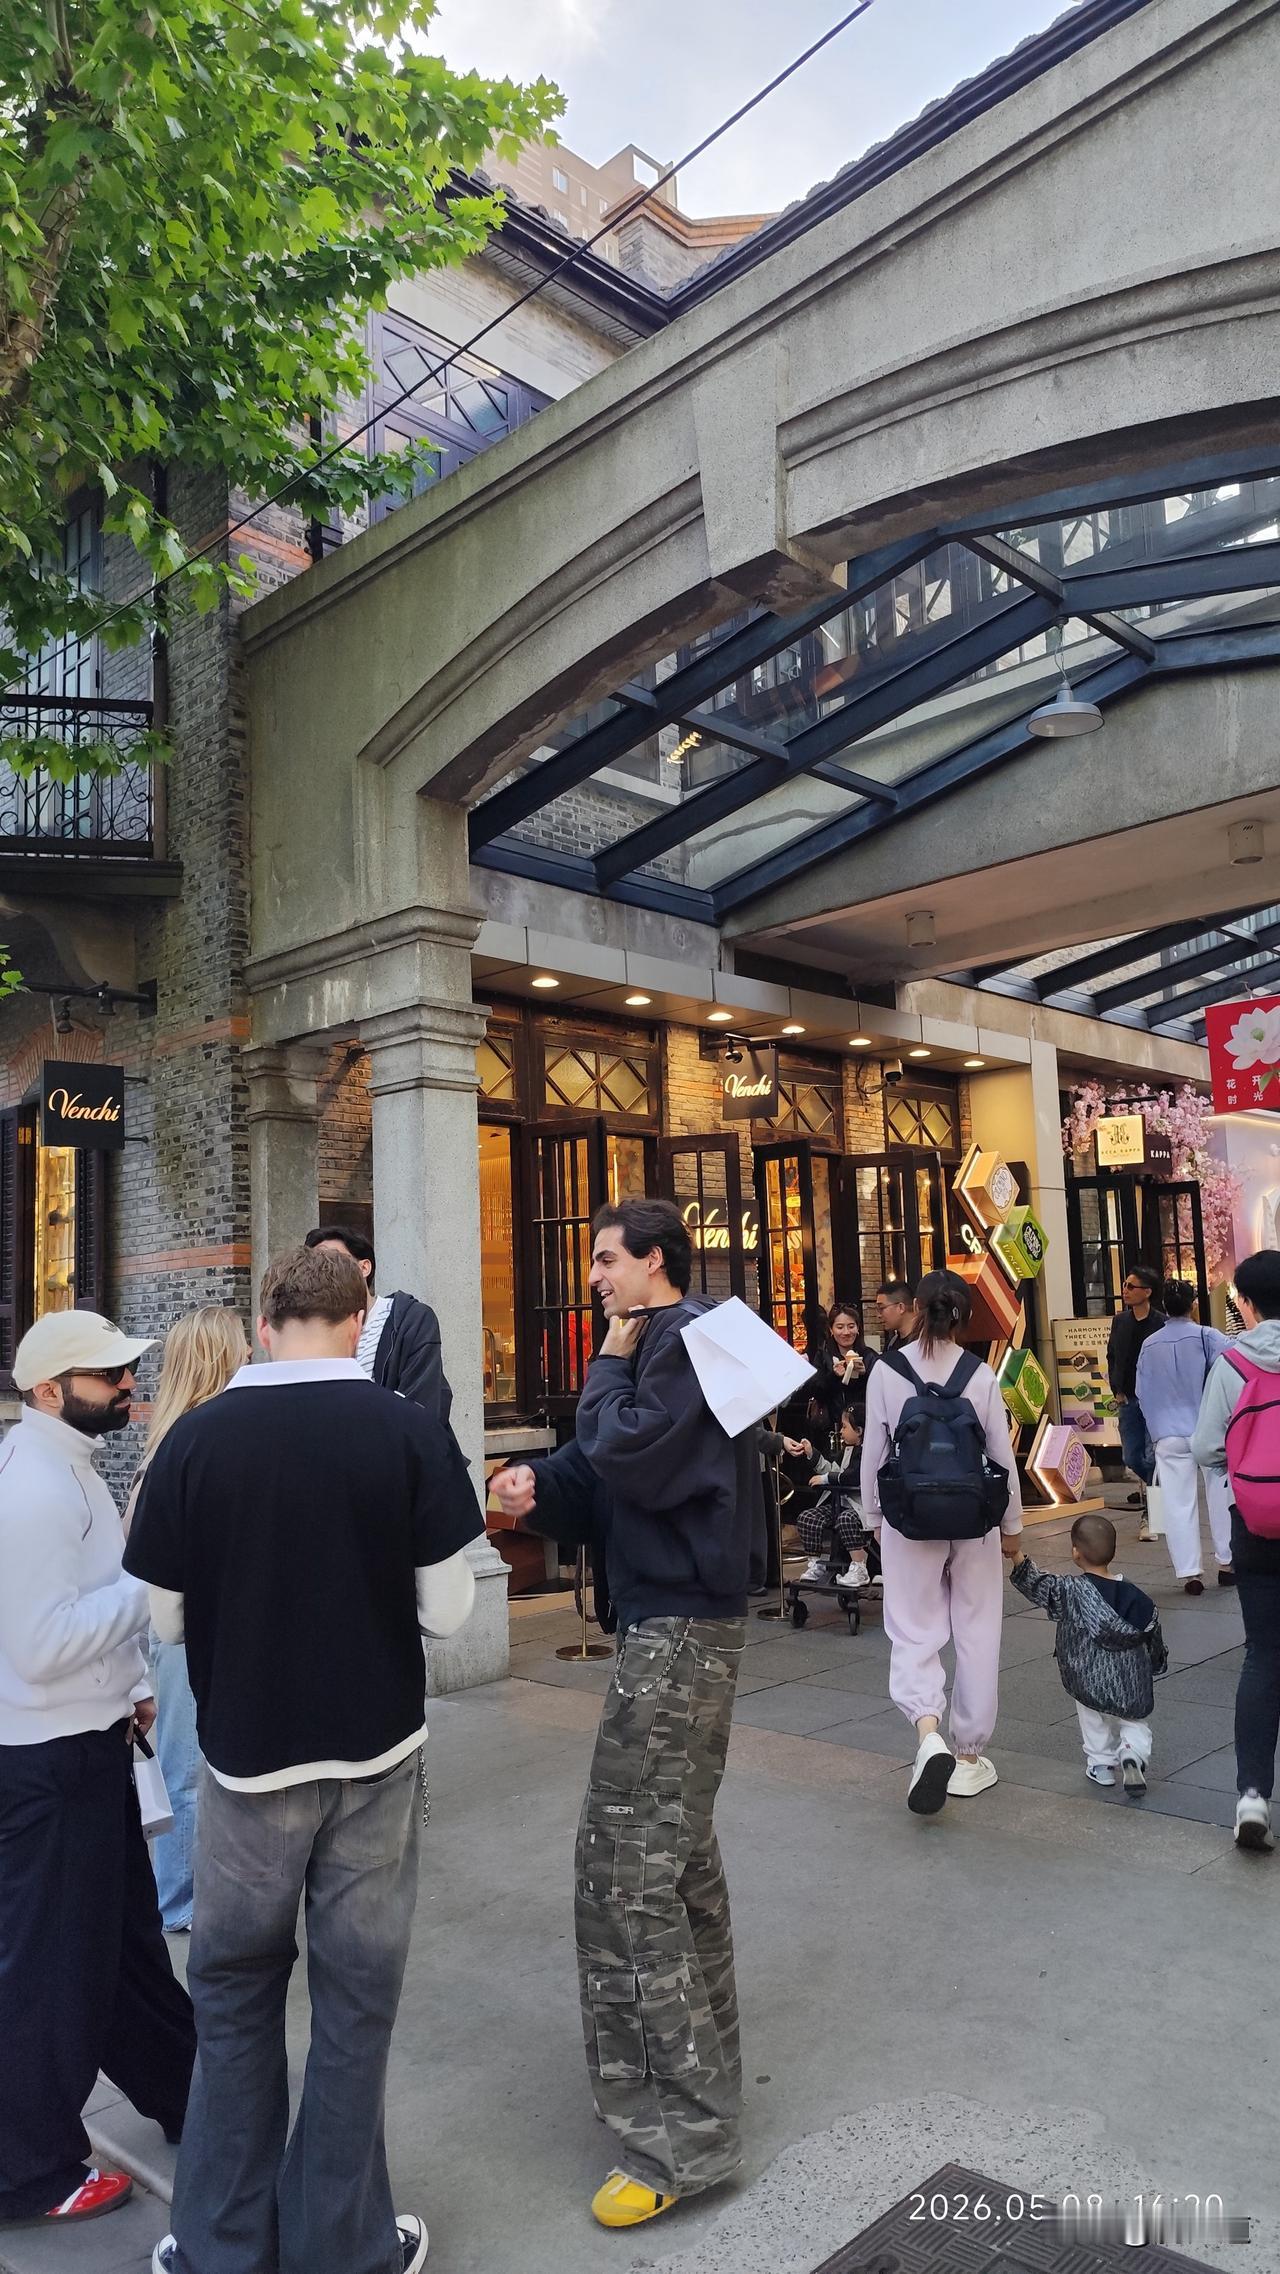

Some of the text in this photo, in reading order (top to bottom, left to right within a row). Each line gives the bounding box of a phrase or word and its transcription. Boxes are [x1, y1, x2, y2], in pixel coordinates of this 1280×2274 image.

[725, 1073, 772, 1098] Venchi
[48, 1088, 121, 1121] Venchi
[1150, 1150, 1171, 1159] KAPPA
[683, 1202, 759, 1250] Venhi
